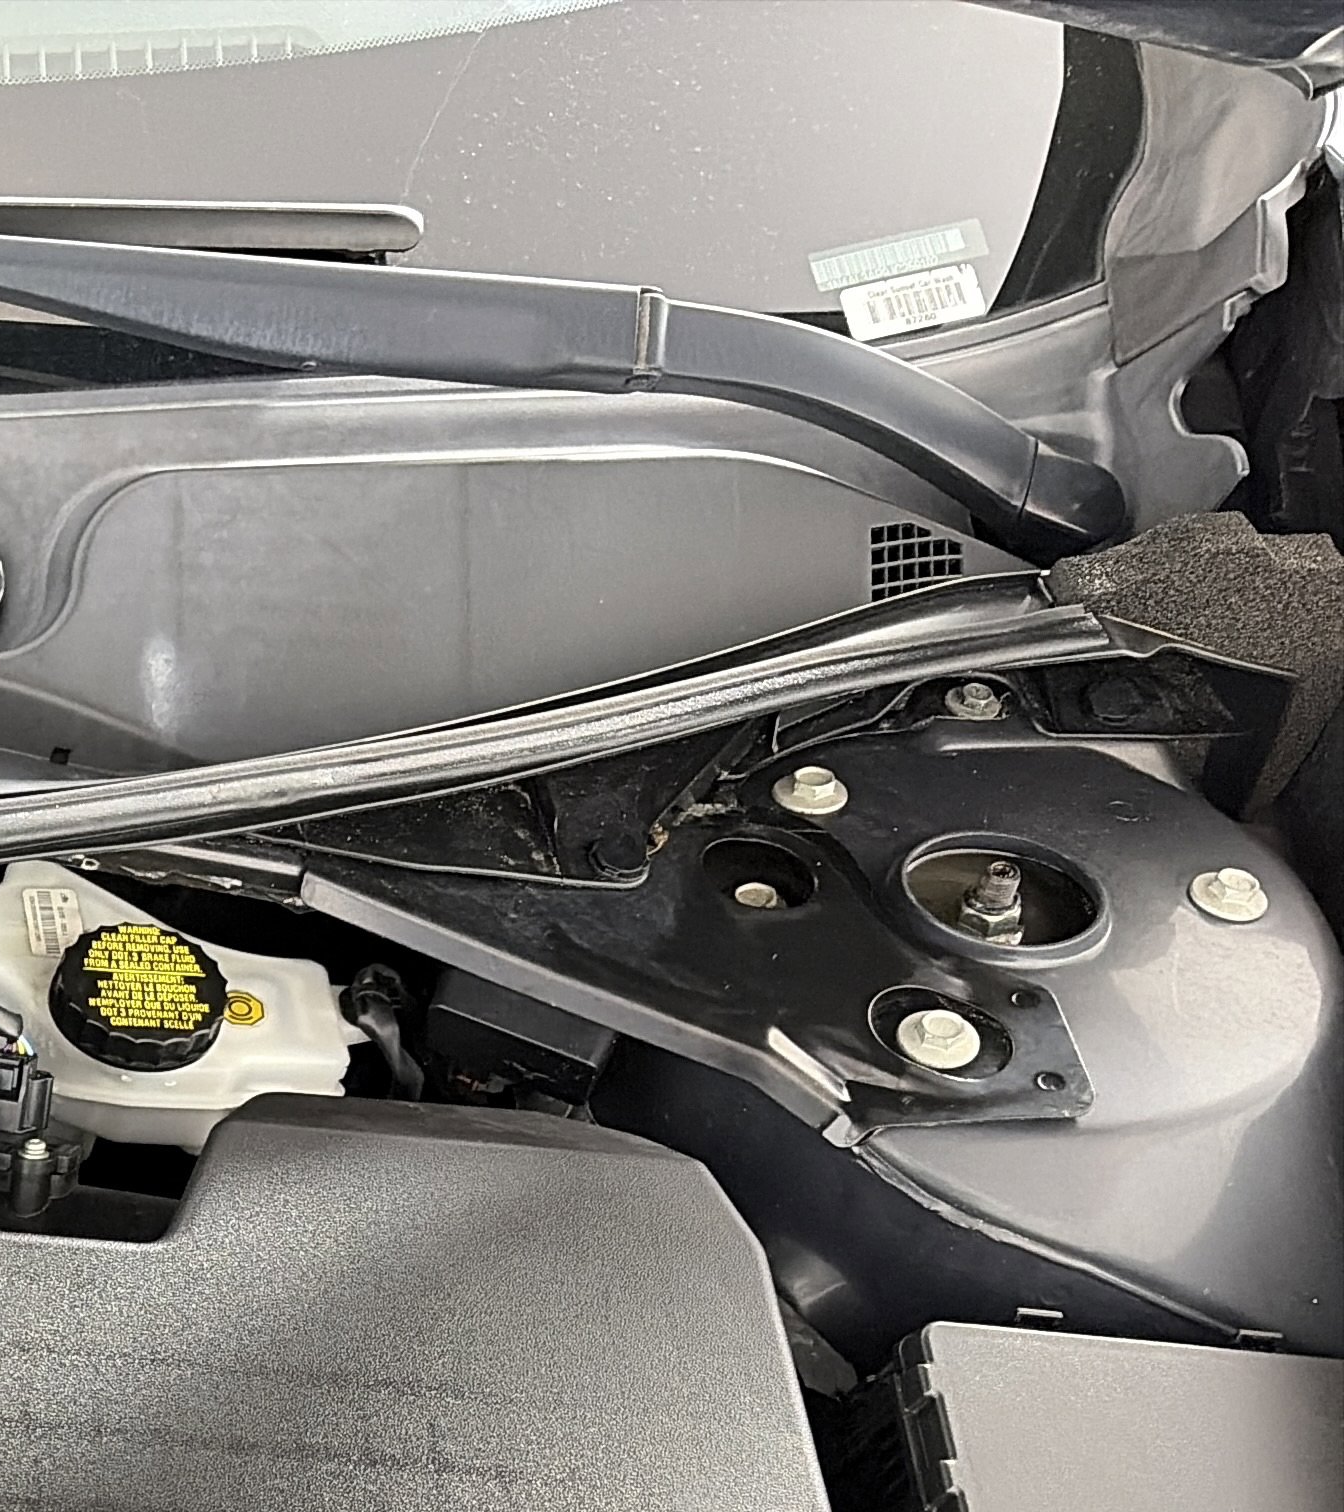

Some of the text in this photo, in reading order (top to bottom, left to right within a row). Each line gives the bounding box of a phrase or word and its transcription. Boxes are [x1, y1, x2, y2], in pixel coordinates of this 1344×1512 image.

[101, 932, 177, 945] CLEAN FILLER CAP
[92, 941, 124, 951] BEFORE
[173, 945, 189, 954] USE
[88, 949, 109, 959] ONLY
[141, 953, 169, 962] BRAKE
[171, 954, 196, 964] FLUID
[84, 958, 109, 968] FROM
[111, 960, 117, 968] A
[119, 960, 151, 970] SEALED
[97, 980, 142, 991] NETTOYER
[156, 984, 196, 994] BOUCHON
[101, 989, 129, 999] AVANT
[131, 992, 143, 1000] DE
[100, 1007, 117, 1016] DOT
[120, 1008, 126, 1016] 3
[128, 1009, 179, 1019] PROVENANT
[144, 1001, 161, 1010] QUE
[163, 1002, 175, 1011] DU
[177, 1003, 210, 1013] LIQUIDE
[110, 1017, 161, 1028] CONTENANT
